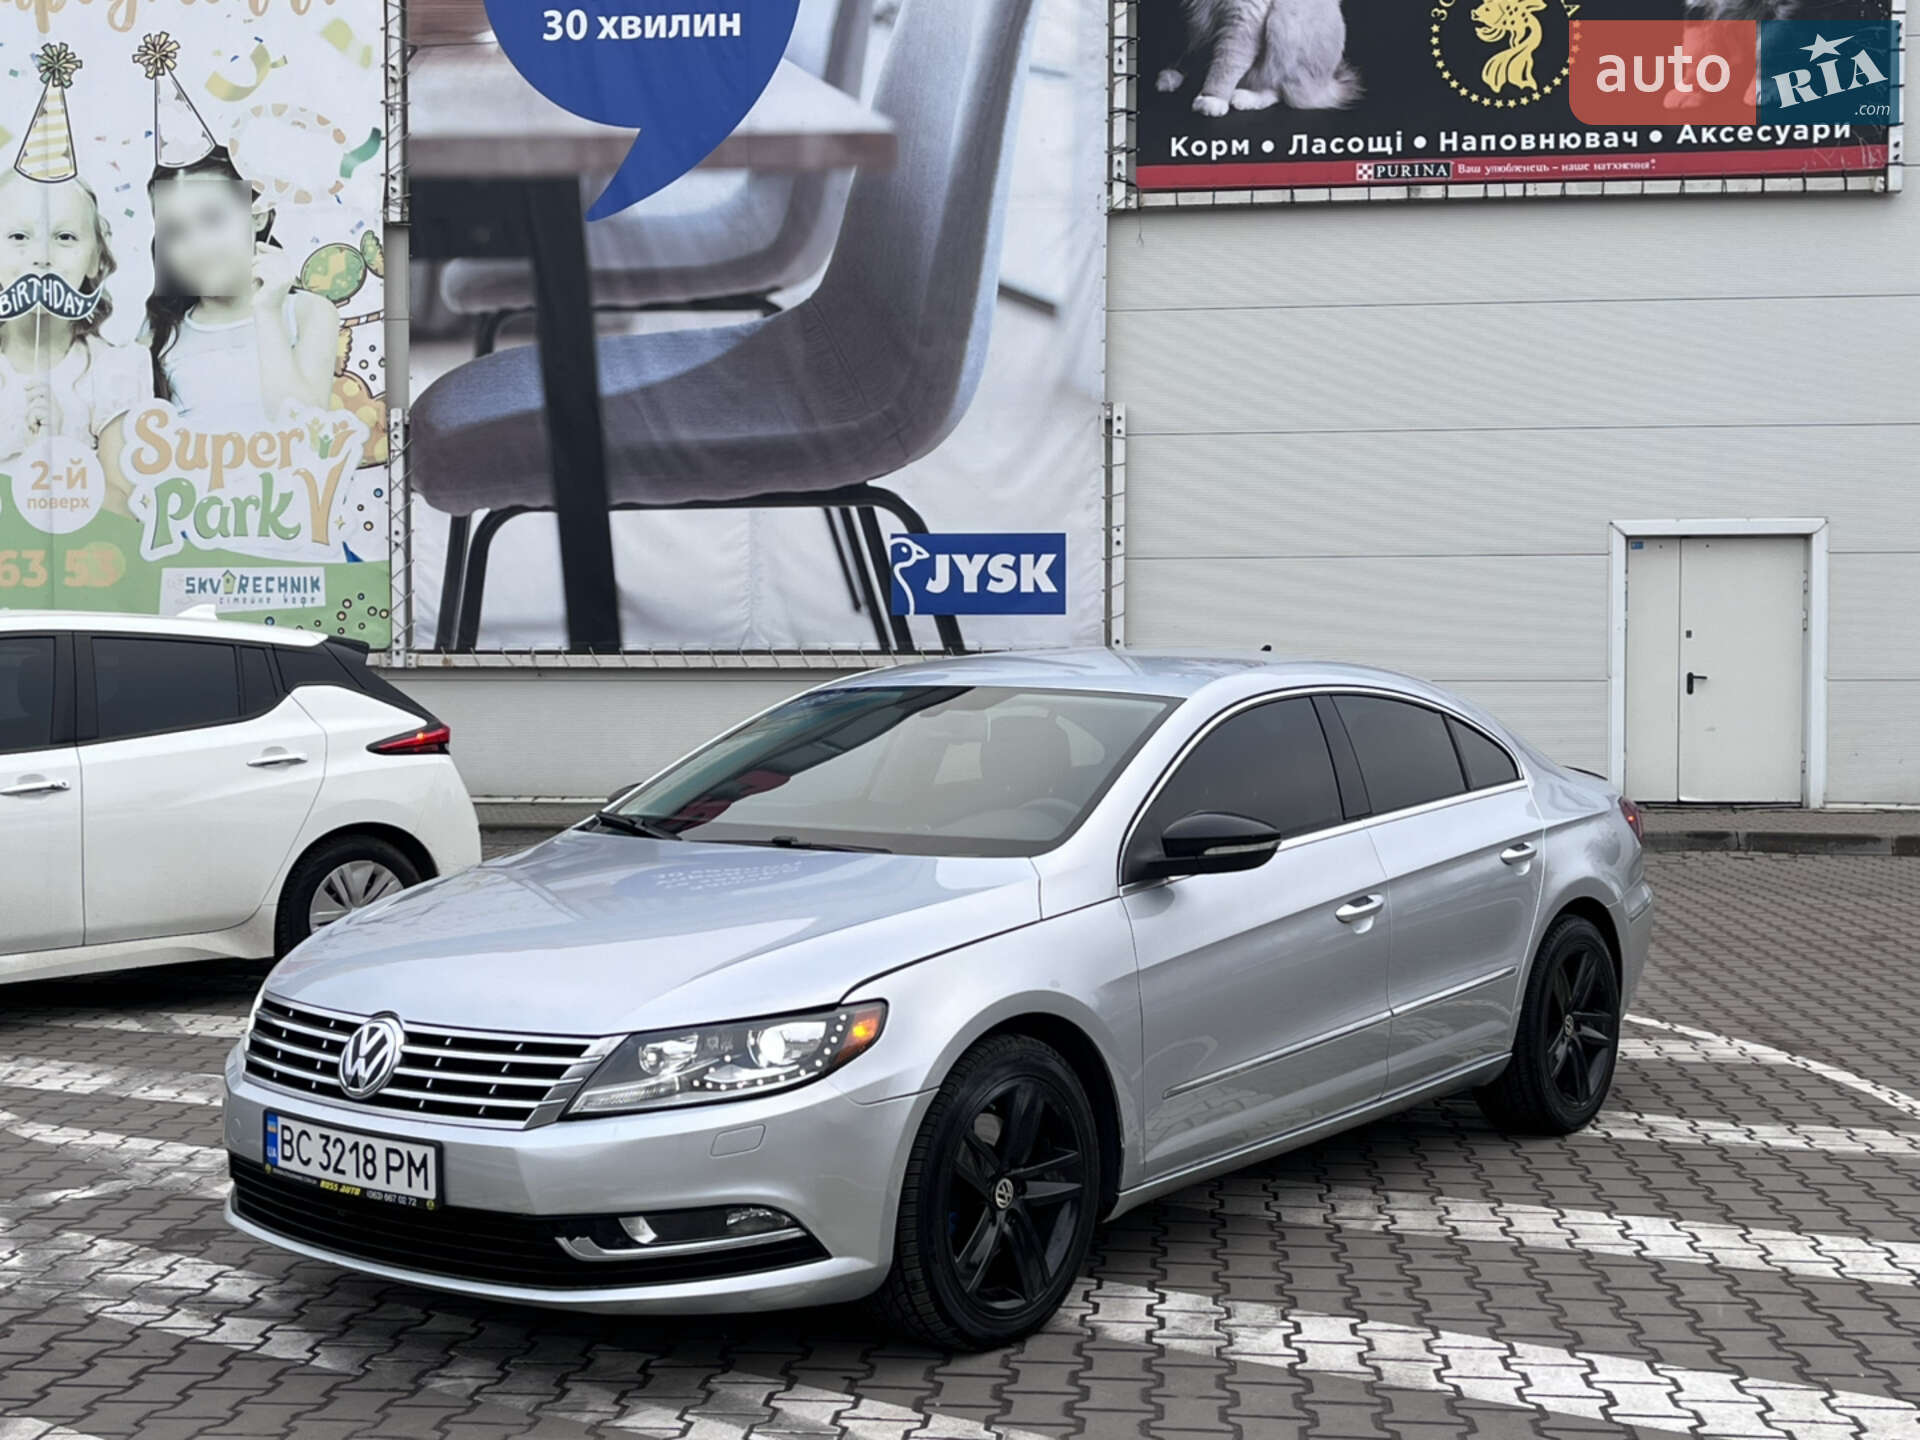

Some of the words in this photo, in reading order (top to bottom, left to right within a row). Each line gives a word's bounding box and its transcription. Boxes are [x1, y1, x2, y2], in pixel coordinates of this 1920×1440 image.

[542, 9, 588, 41] 30
[597, 12, 741, 40] хвилин
[1171, 136, 1250, 160] Корм
[1288, 131, 1402, 156] Ласощі
[1440, 131, 1639, 152] Наповнювач
[1676, 124, 1851, 145] Аксесуари
[1375, 163, 1449, 178] PURINA
[1457, 163, 1481, 174] Ваш
[1561, 162, 1590, 172] наше
[131, 408, 305, 492] Super
[31, 458, 88, 491] 2-й
[27, 497, 90, 512] поверх
[150, 472, 301, 551] Park
[185, 574, 321, 595] SKVRECHNIK
[925, 553, 1058, 594] JYSK
[280, 1124, 312, 1166] BC
[318, 1133, 377, 1181] 3218
[385, 1147, 429, 1191] PM
